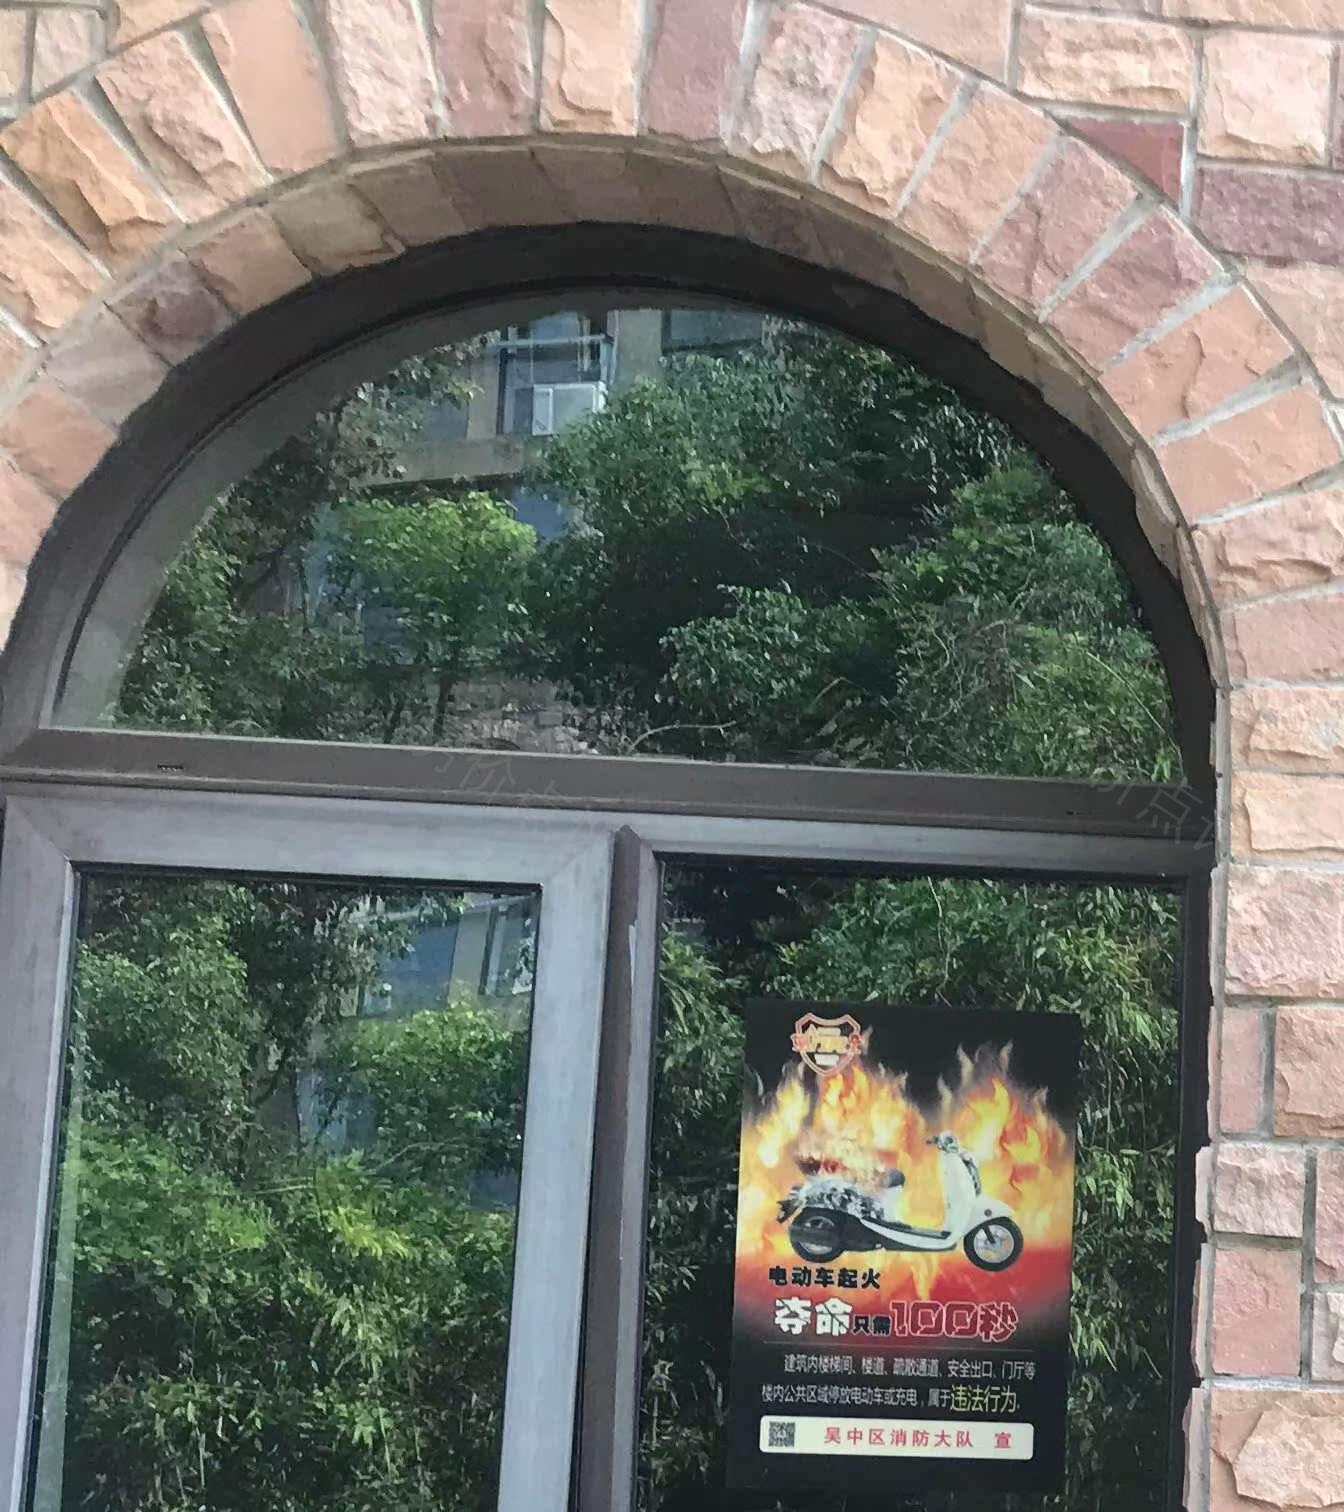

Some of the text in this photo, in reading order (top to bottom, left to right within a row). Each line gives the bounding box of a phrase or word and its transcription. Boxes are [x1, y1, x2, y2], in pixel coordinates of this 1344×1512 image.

[768, 1265, 881, 1289] 电动车起火
[823, 1426, 1012, 1449] 吴中区消防大队 宣
